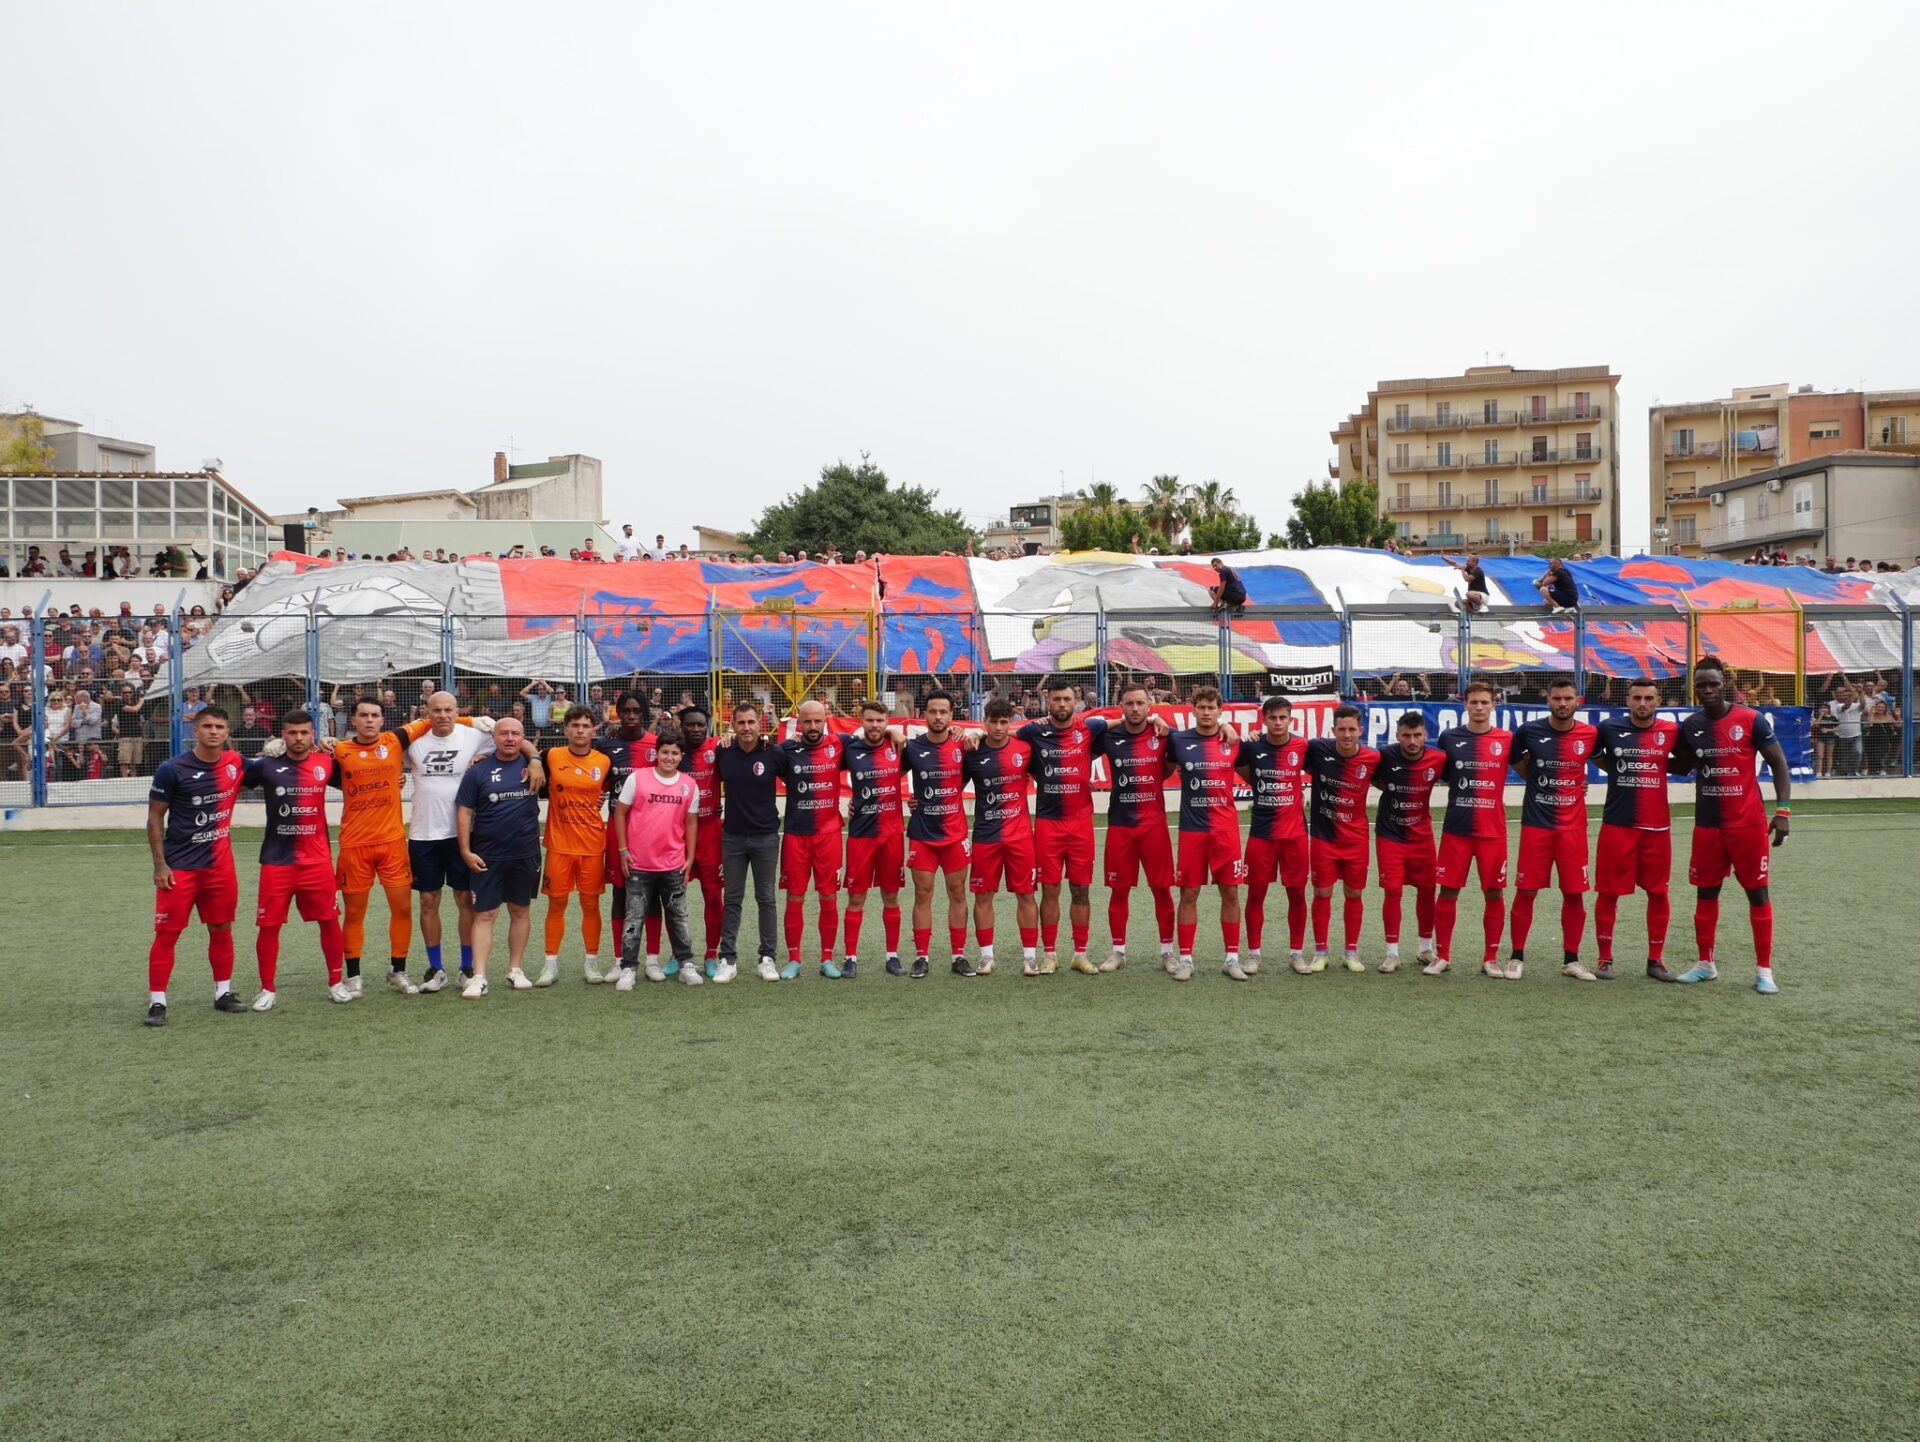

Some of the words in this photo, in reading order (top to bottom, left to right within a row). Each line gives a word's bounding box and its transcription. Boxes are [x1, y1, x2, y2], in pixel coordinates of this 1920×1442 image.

[1270, 671, 1333, 687] DIFFIDATI
[1623, 748, 1664, 756] ermeslink
[1703, 746, 1742, 754] ermeslink
[1122, 756, 1158, 764] ermeslink
[1464, 760, 1501, 768] ermeslink
[802, 762, 837, 771] ermeslink
[1627, 762, 1658, 770] EGEA
[863, 767, 899, 777] ermeslink
[1261, 769, 1297, 777] ermeslink
[491, 774, 501, 782] FC
[1627, 777, 1660, 785] GENERALI
[358, 780, 390, 791] EGEA
[1266, 782, 1293, 790] EGEA
[1709, 785, 1743, 793] GENERALI
[871, 786, 896, 795] EGEA
[935, 787, 958, 795] EGEA
[996, 792, 1020, 800] EGEA
[1328, 796, 1355, 805] EGEA
[291, 806, 318, 814] EGEA
[1760, 856, 1768, 871] 6
